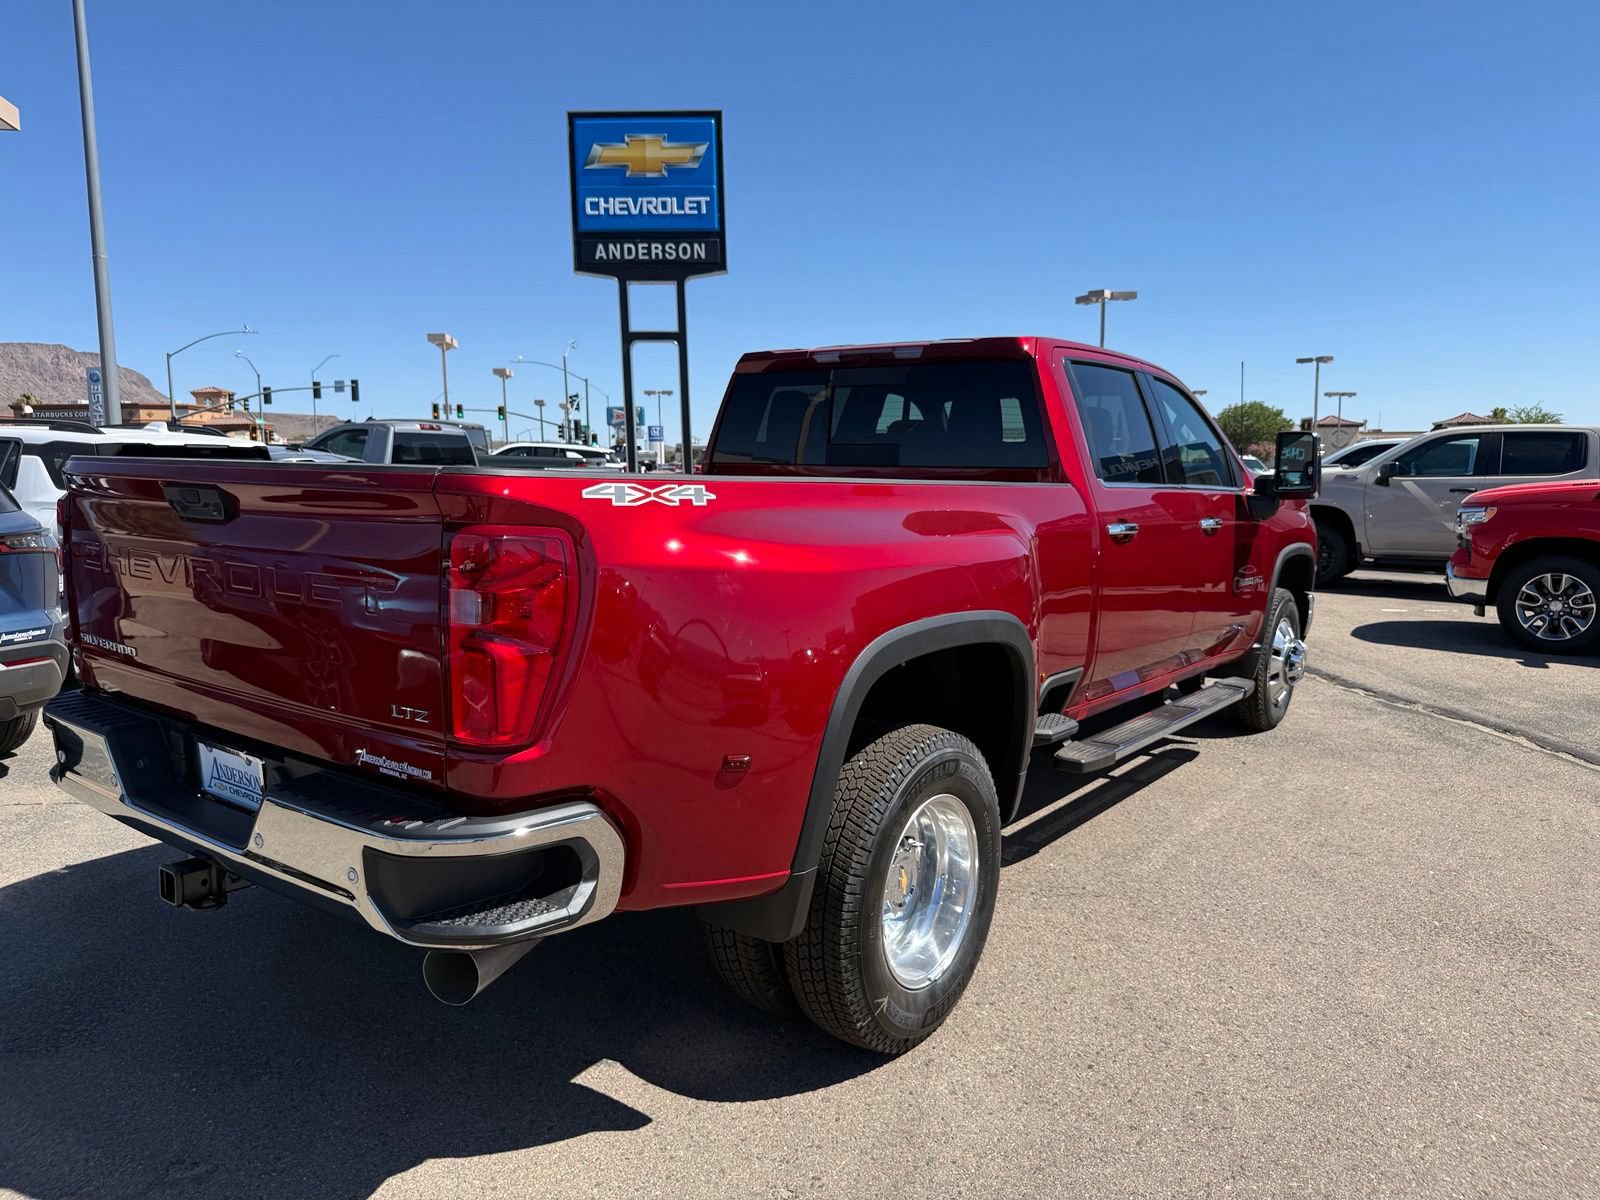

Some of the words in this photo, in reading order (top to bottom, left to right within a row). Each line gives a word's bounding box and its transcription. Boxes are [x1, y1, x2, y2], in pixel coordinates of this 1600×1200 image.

[585, 197, 710, 215] CHEVROLET
[595, 243, 706, 260] ANDERSON
[32, 411, 73, 419] STARBUCKS
[80, 540, 402, 616] CHEVROLET
[80, 632, 136, 657] SILVERADO
[391, 704, 429, 723] LTZ
[207, 756, 262, 792] ANDERSON
